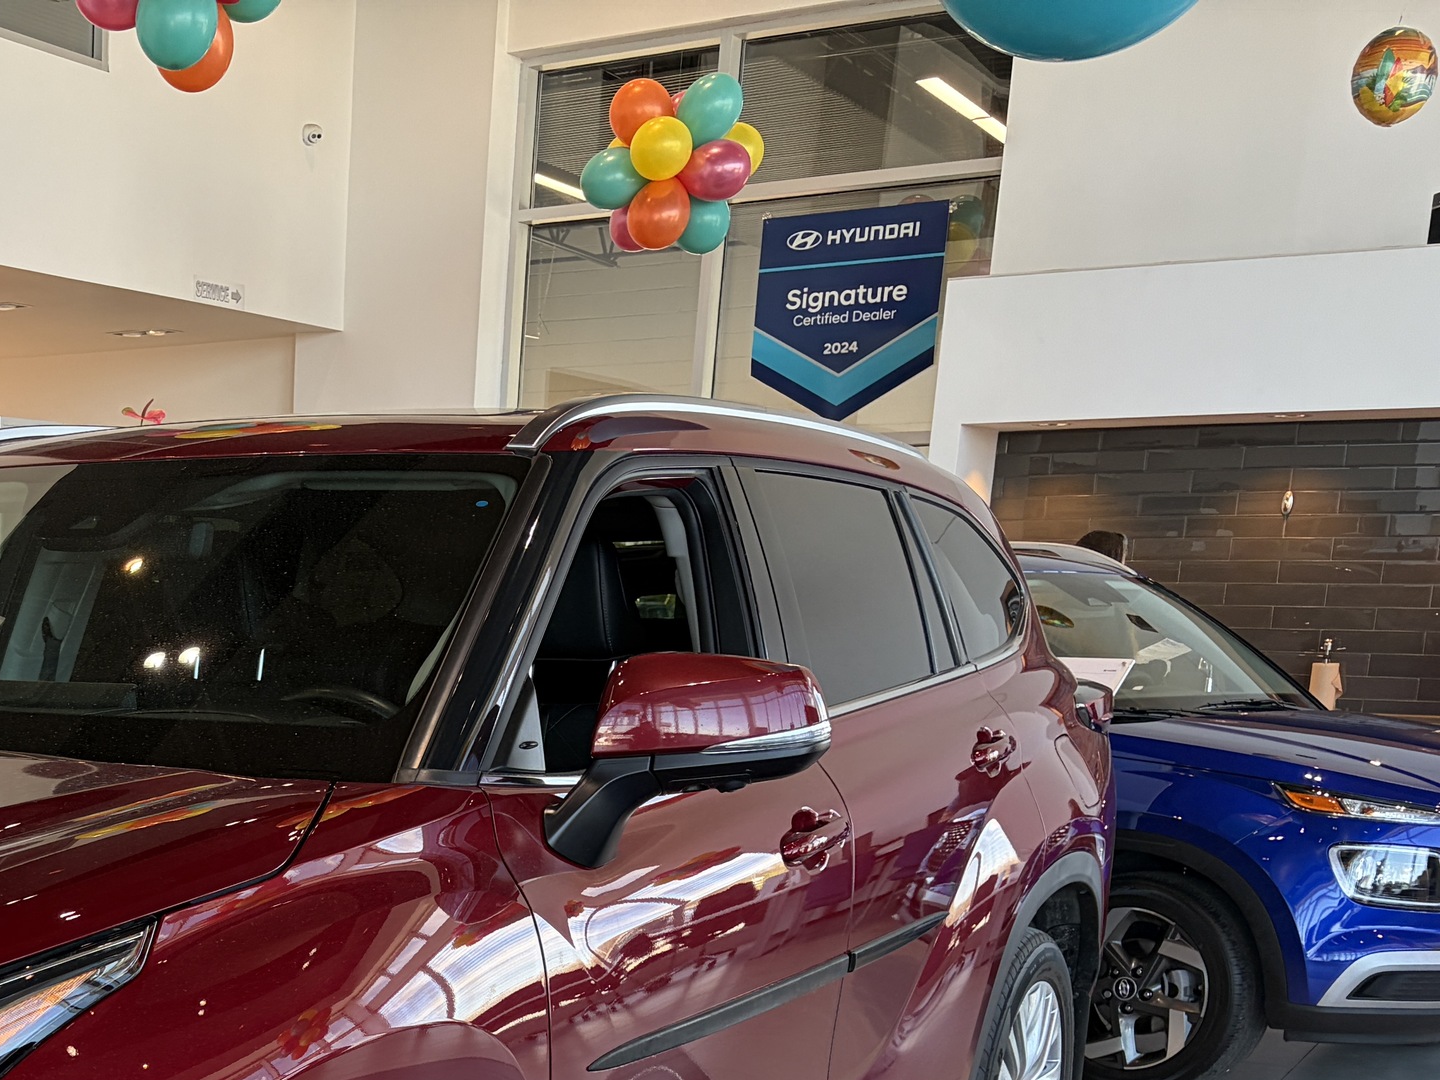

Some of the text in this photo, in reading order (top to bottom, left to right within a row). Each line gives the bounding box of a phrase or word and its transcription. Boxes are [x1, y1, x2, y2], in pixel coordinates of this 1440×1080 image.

[827, 222, 920, 245] HYUNDAI
[785, 284, 908, 313] Signature
[793, 308, 897, 327] Certified Dealer
[823, 341, 858, 355] 2024
